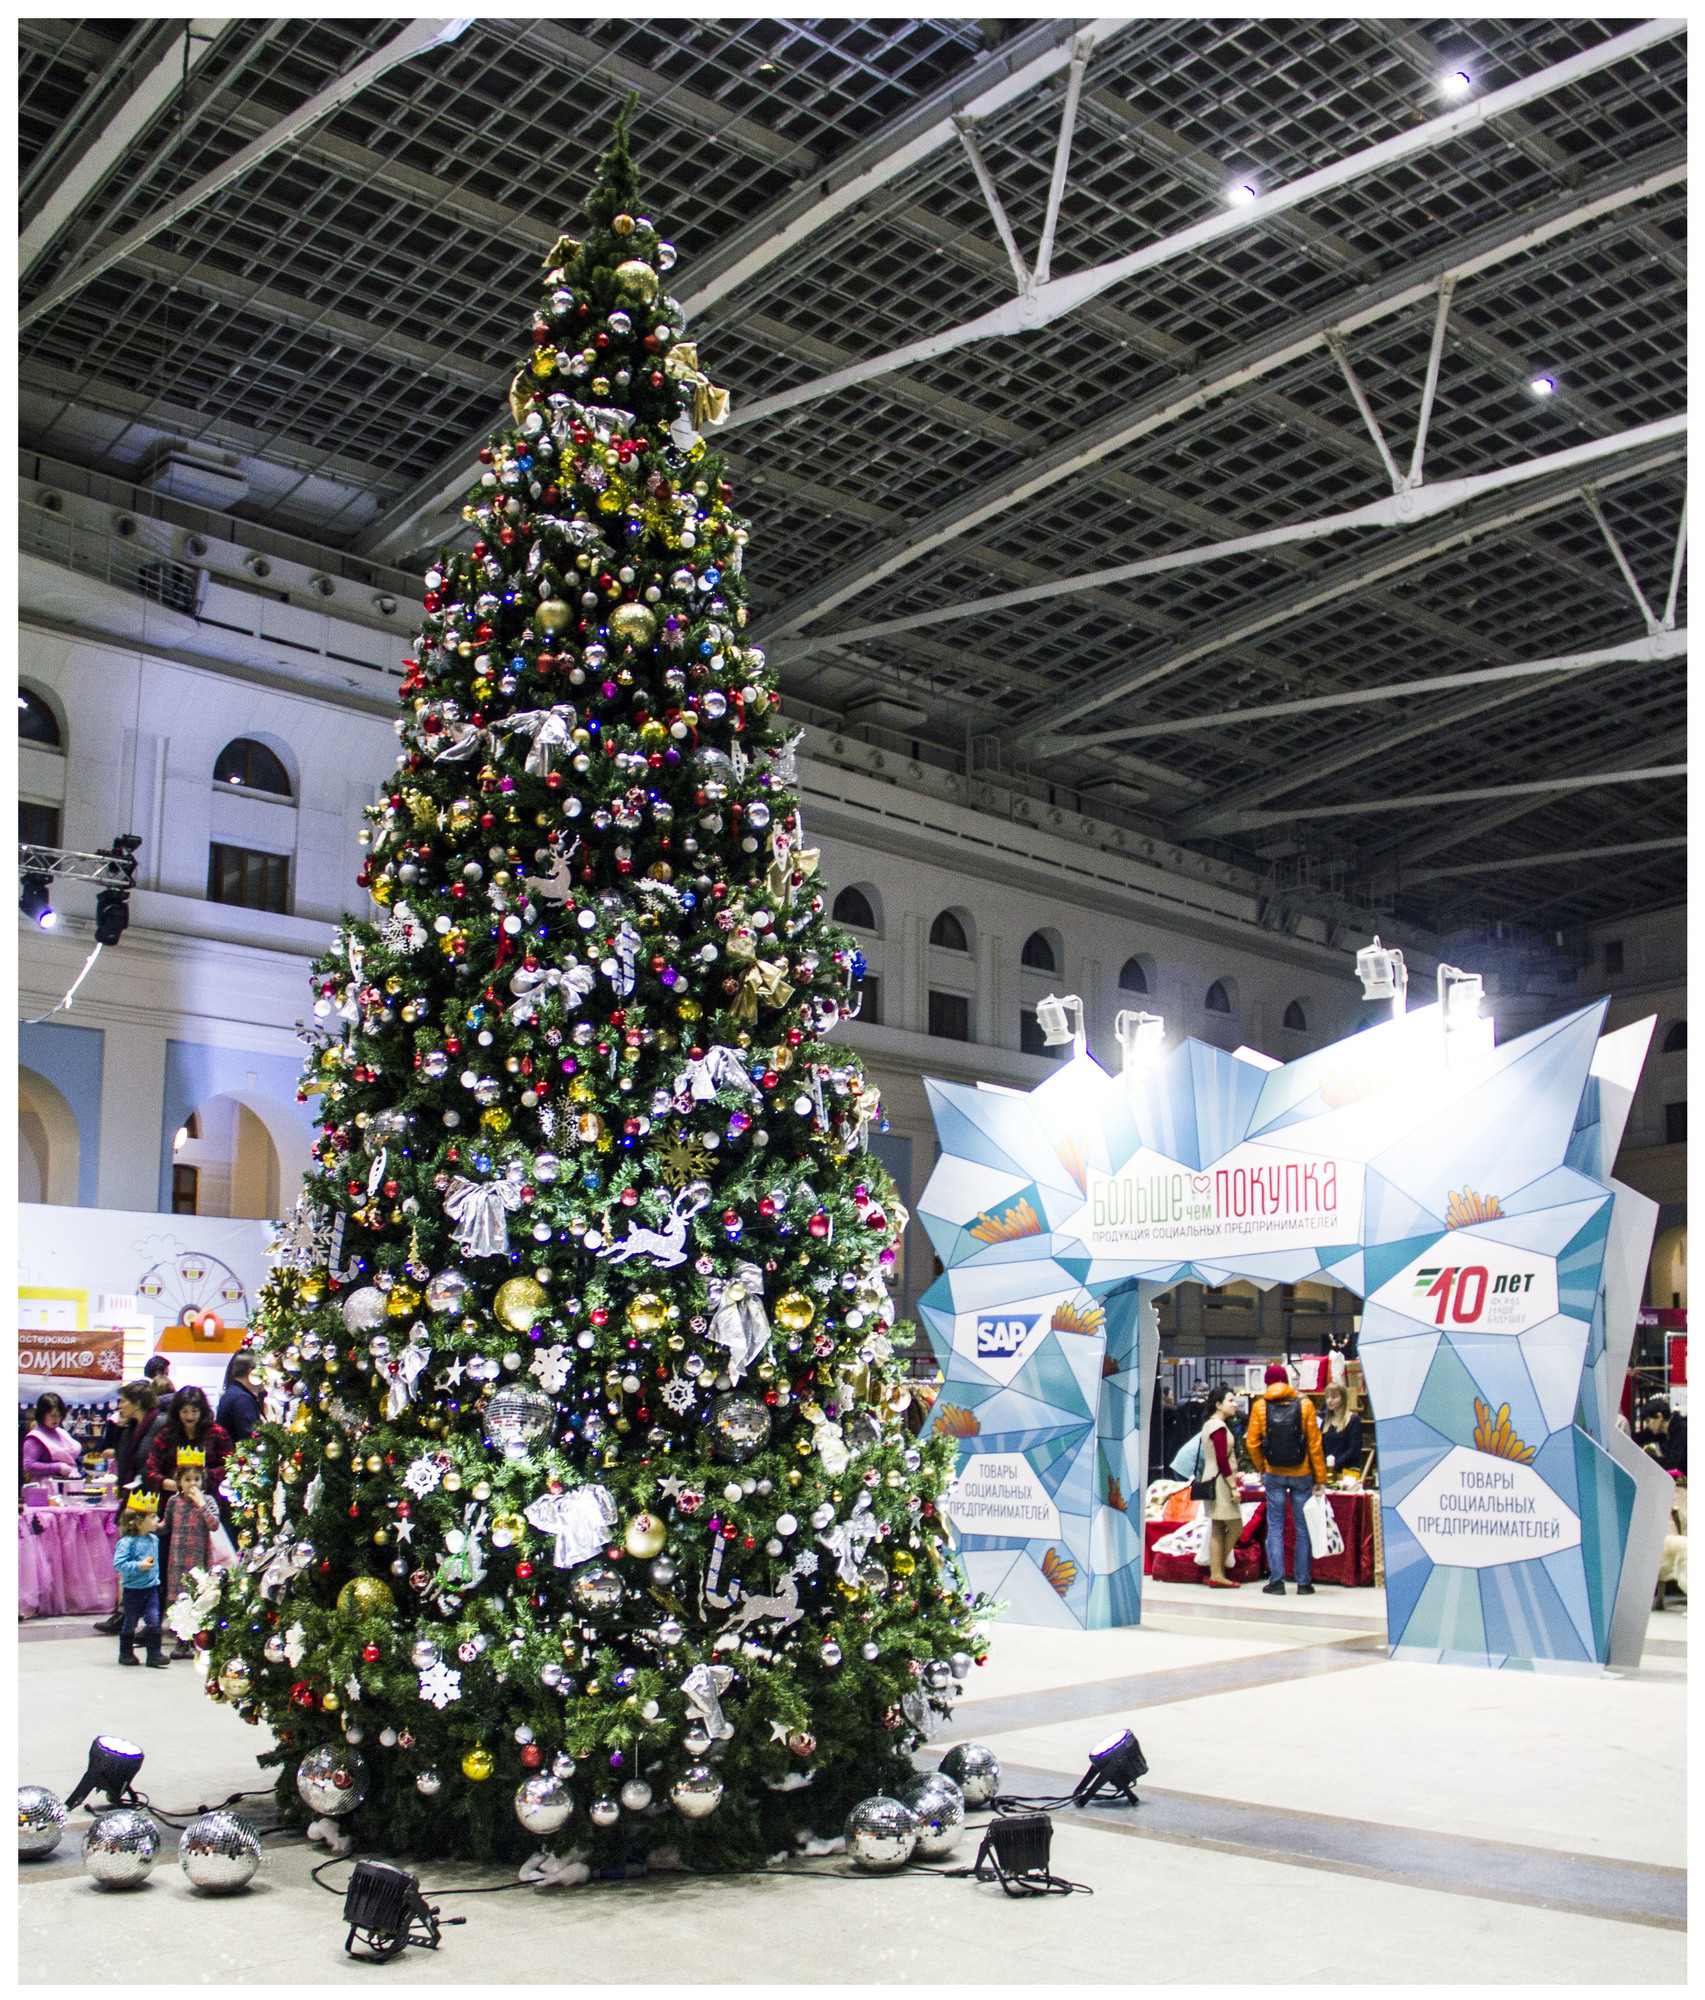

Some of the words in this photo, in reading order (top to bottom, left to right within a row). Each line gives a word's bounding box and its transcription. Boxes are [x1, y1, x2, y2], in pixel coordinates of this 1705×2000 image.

[1186, 1204, 1212, 1221] чем
[1093, 1229, 1150, 1243] ПРОДУКЦИЯ
[1152, 1223, 1222, 1240] СОЦИАЛЬНЫХ
[1224, 1216, 1338, 1236] ПРЕДПРИНИМАТЕЛЕЙ
[1426, 1265, 1489, 1325] 10
[1492, 1273, 1535, 1294] лет
[978, 1322, 1027, 1351] SAP
[979, 1464, 1018, 1480] ТОВАРЫ
[1460, 1471, 1515, 1490] ТОВАРЫ
[965, 1482, 1033, 1501] СОЦИАЛЬНЫХ
[950, 1500, 1050, 1521] ПРЕДПРИНИМАТЕЛЕЙ
[1439, 1494, 1536, 1514] СОЦИАЛЬНЫХ
[1417, 1515, 1560, 1539] ПРЕДПРИНИМАТЕЛЕЙ
